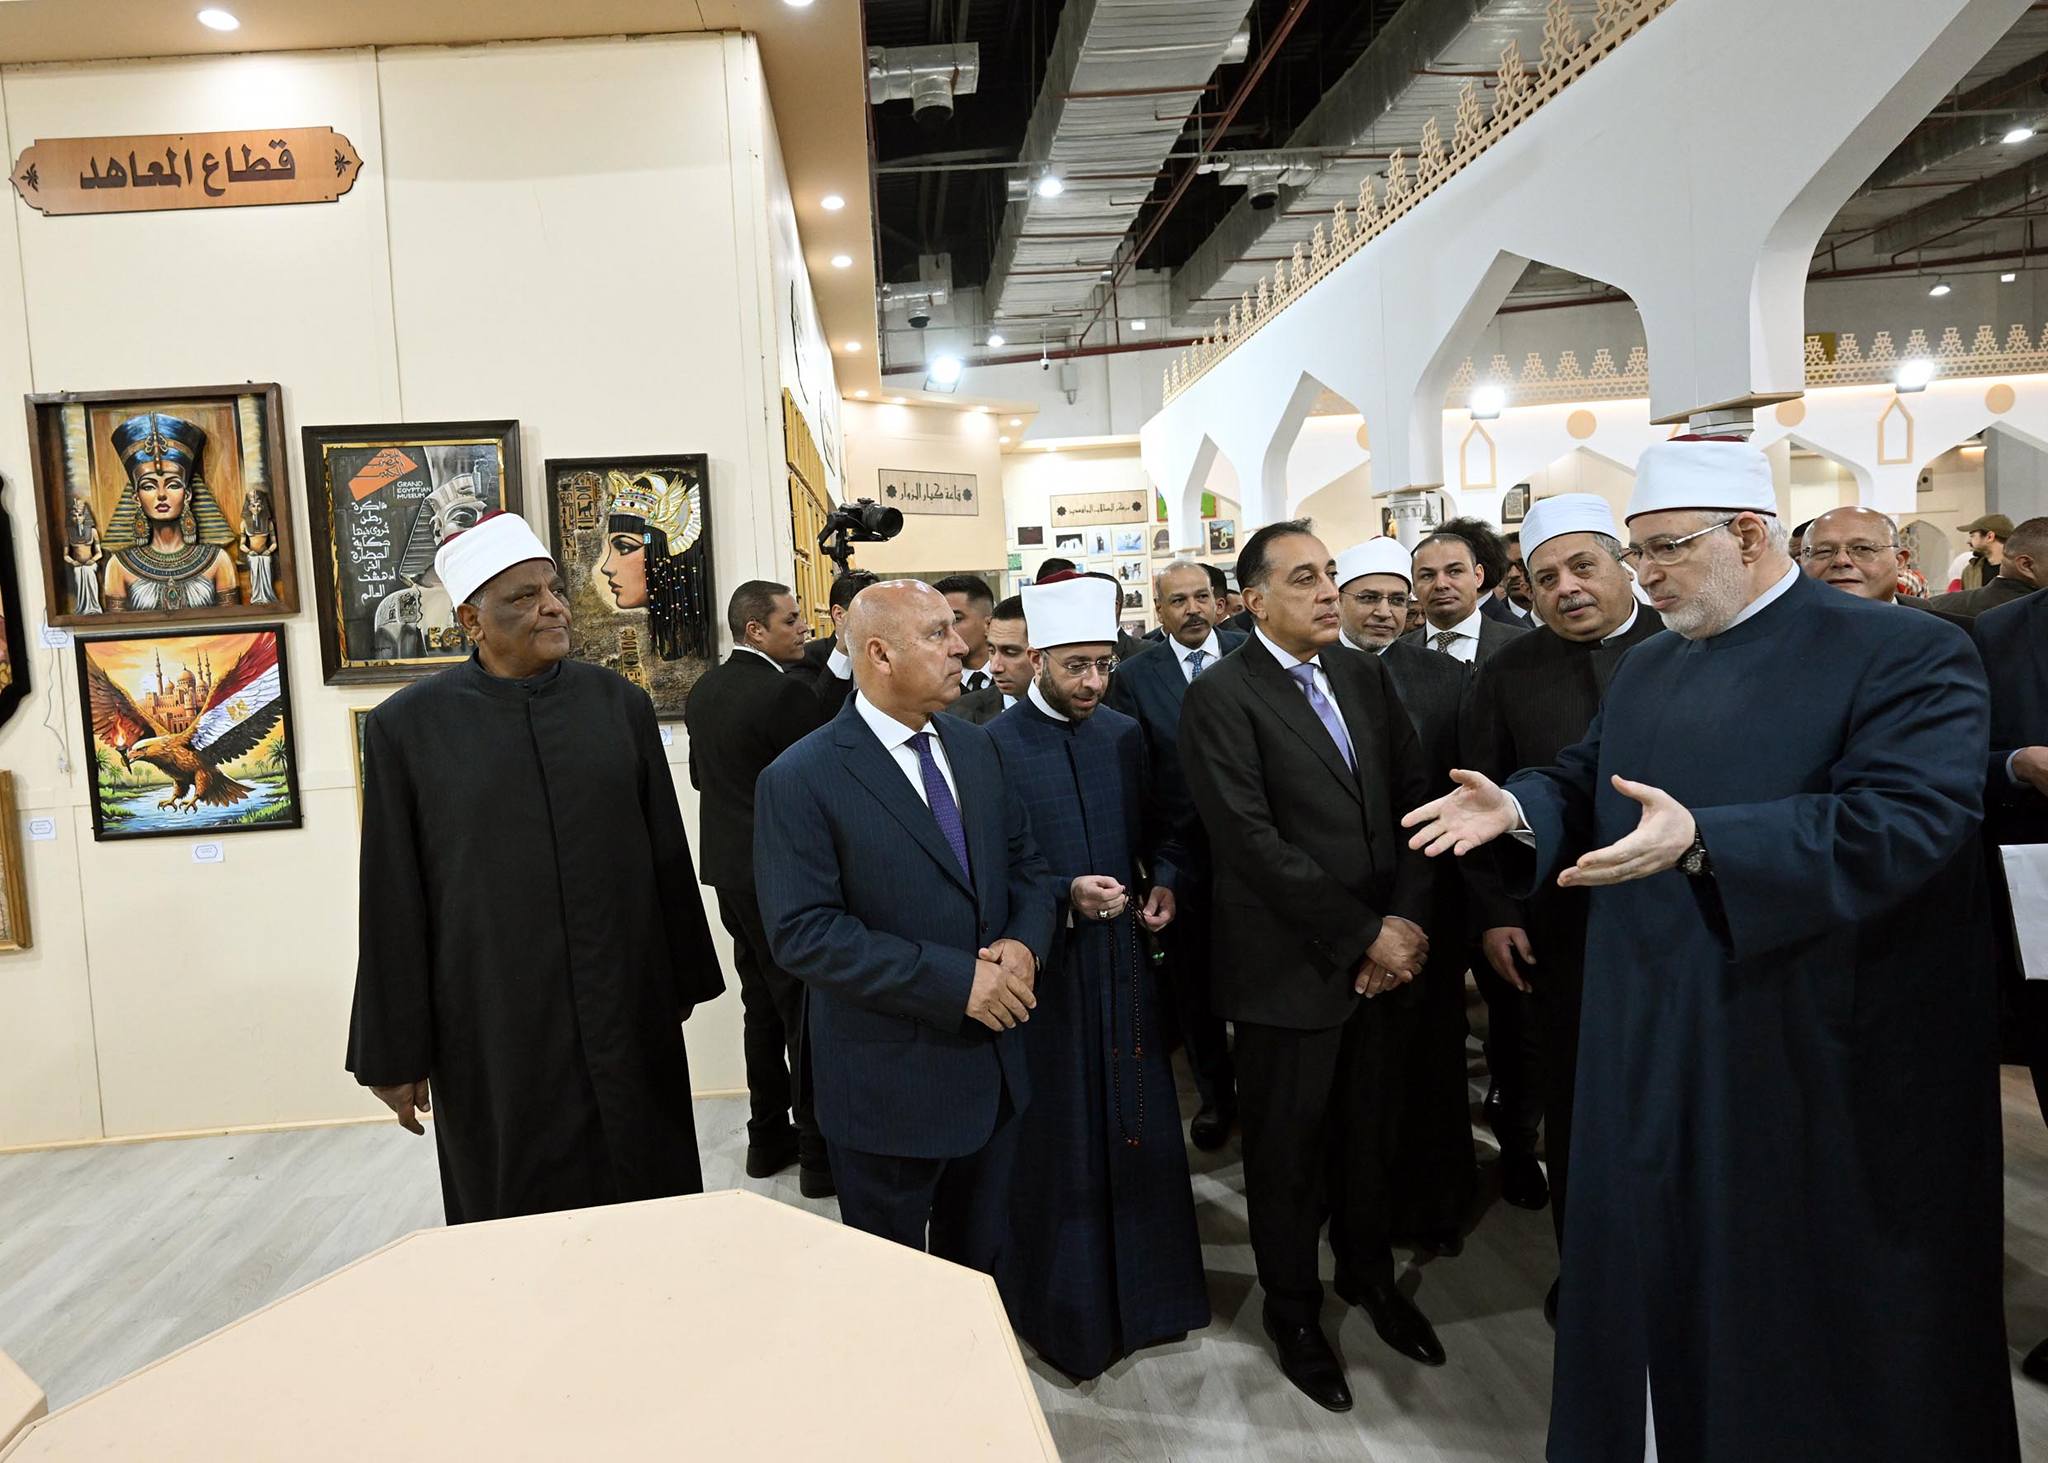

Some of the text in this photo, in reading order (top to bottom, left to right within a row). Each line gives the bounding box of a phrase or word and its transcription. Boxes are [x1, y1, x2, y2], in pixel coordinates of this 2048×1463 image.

[79, 138, 296, 197] قطاع المعاهد
[396, 480, 424, 488] GRAND
